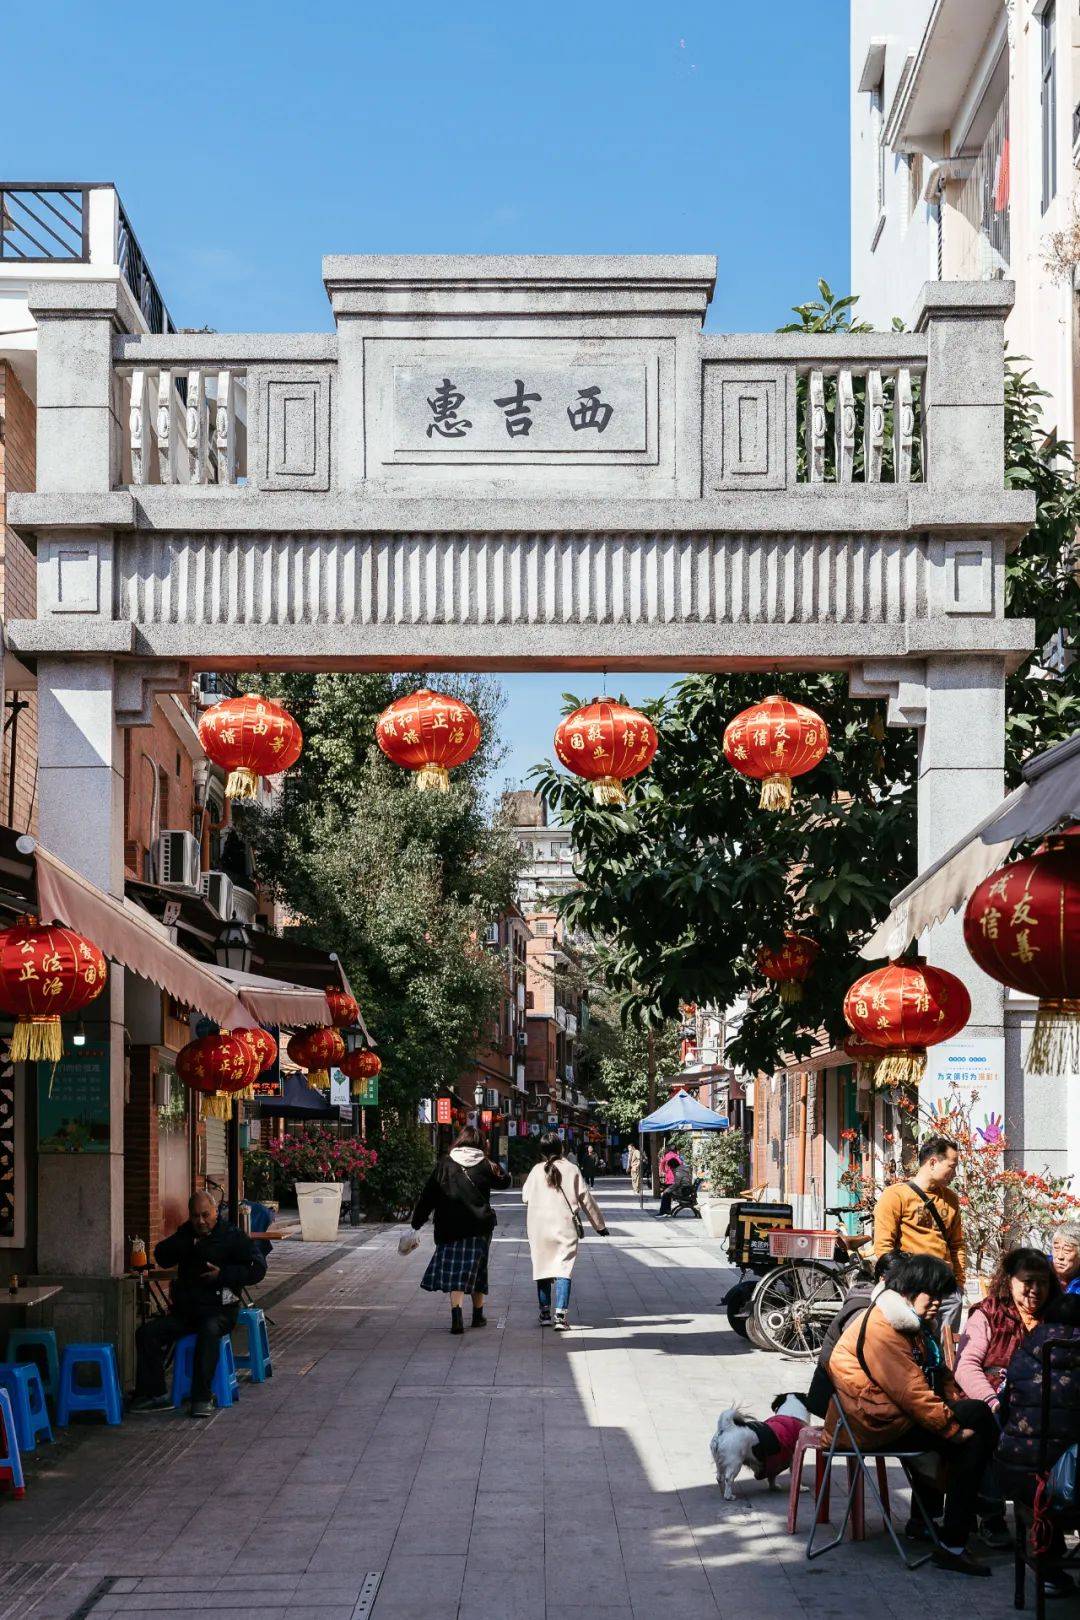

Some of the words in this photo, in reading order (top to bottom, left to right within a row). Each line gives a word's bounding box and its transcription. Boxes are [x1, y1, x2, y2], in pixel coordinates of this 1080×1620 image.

[426, 378, 614, 439] 惠吉西
[253, 703, 269, 736] 自由
[268, 717, 285, 753] 平等
[396, 711, 420, 745] 和谐
[586, 722, 606, 759] 敬业
[634, 726, 652, 762] 友善
[769, 720, 791, 757] 友善
[1010, 892, 1041, 963] 友善
[16, 938, 40, 981] 公正
[42, 951, 64, 997] 法治
[79, 942, 97, 985] 爱国
[871, 989, 891, 1030] 敬业
[217, 1044, 232, 1072] 公正
[230, 1054, 246, 1081] 法治
